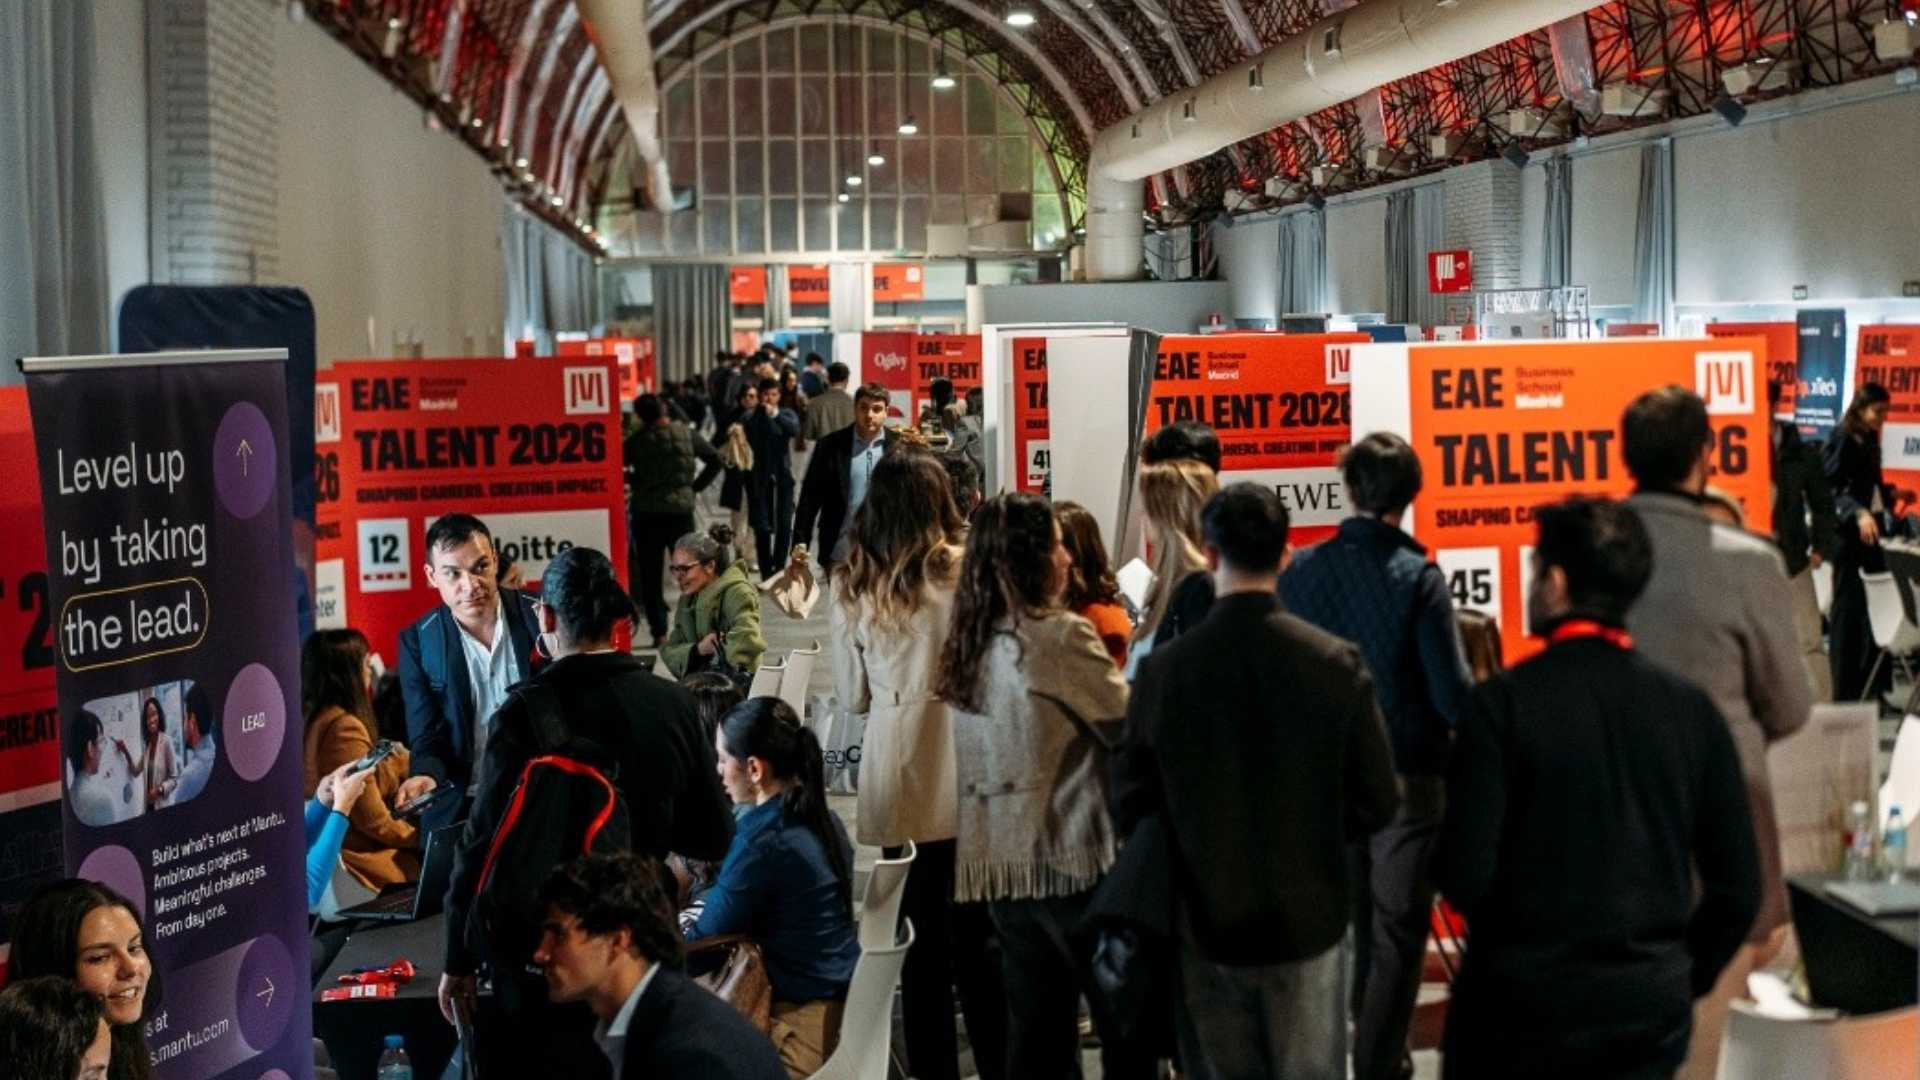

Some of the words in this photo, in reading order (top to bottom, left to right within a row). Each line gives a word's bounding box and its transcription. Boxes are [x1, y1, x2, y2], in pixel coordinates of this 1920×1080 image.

[1024, 349, 1047, 371] EA
[1154, 351, 1201, 380] EAE
[351, 376, 411, 412] EAE
[1431, 367, 1504, 410] EAE
[1154, 393, 1274, 430] TALENT
[354, 425, 500, 472] TALENT
[508, 421, 607, 466] 2026
[1433, 428, 1615, 487] TALENT
[57, 441, 138, 495] Level
[146, 449, 186, 493] up
[1275, 482, 1342, 512] EWE
[1435, 505, 1512, 529] SHAPING
[61, 530, 101, 585] by
[110, 517, 208, 568] taking
[369, 535, 400, 564] 12
[1450, 568, 1492, 606] 45
[64, 608, 123, 657] the
[129, 589, 200, 644] lead.
[151, 843, 181, 867] Build
[216, 824, 239, 845] next
[240, 820, 252, 838] at
[154, 862, 206, 892] Ambitious
[155, 920, 183, 940] From
[184, 911, 205, 929] day
[154, 1009, 169, 1033] at
